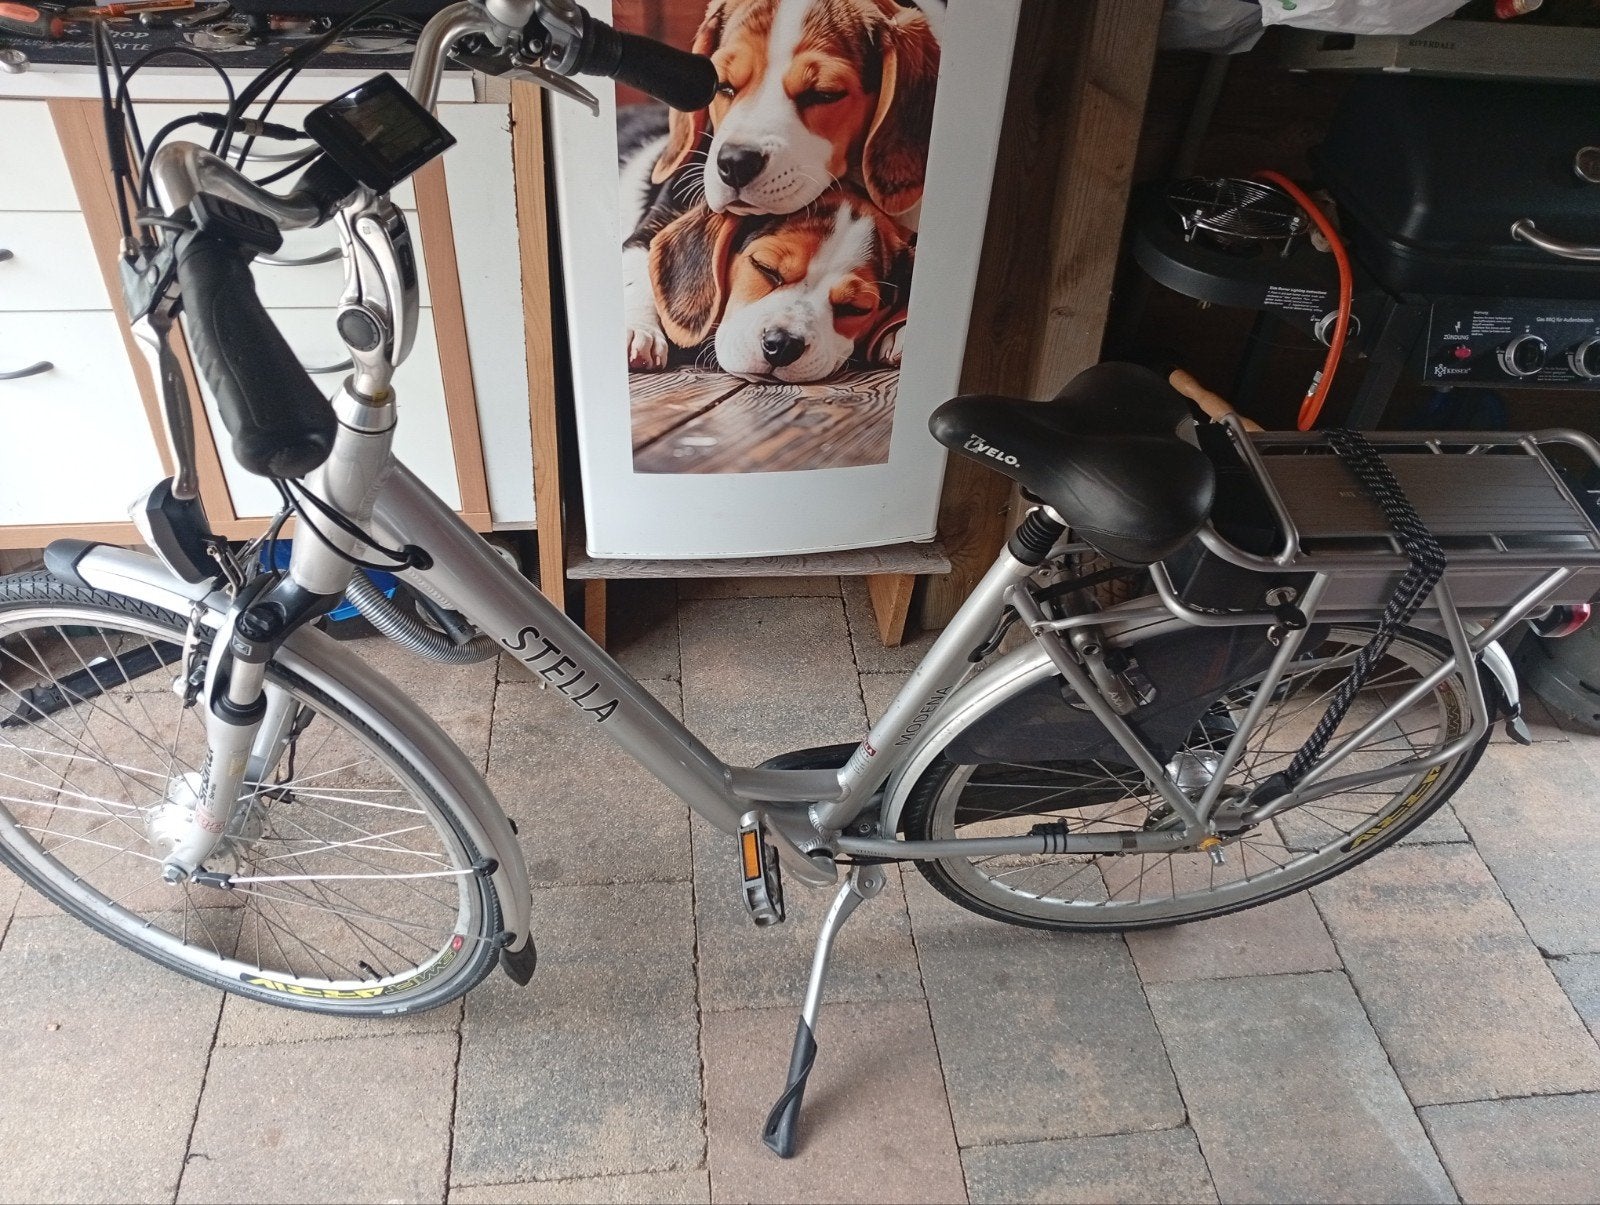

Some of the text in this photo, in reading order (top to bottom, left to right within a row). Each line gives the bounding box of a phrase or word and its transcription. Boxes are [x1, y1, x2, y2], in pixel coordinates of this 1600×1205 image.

[1443, 333, 1470, 341] ZÜNDUNG
[501, 626, 620, 723] STELLA
[895, 685, 953, 746] MODENA
